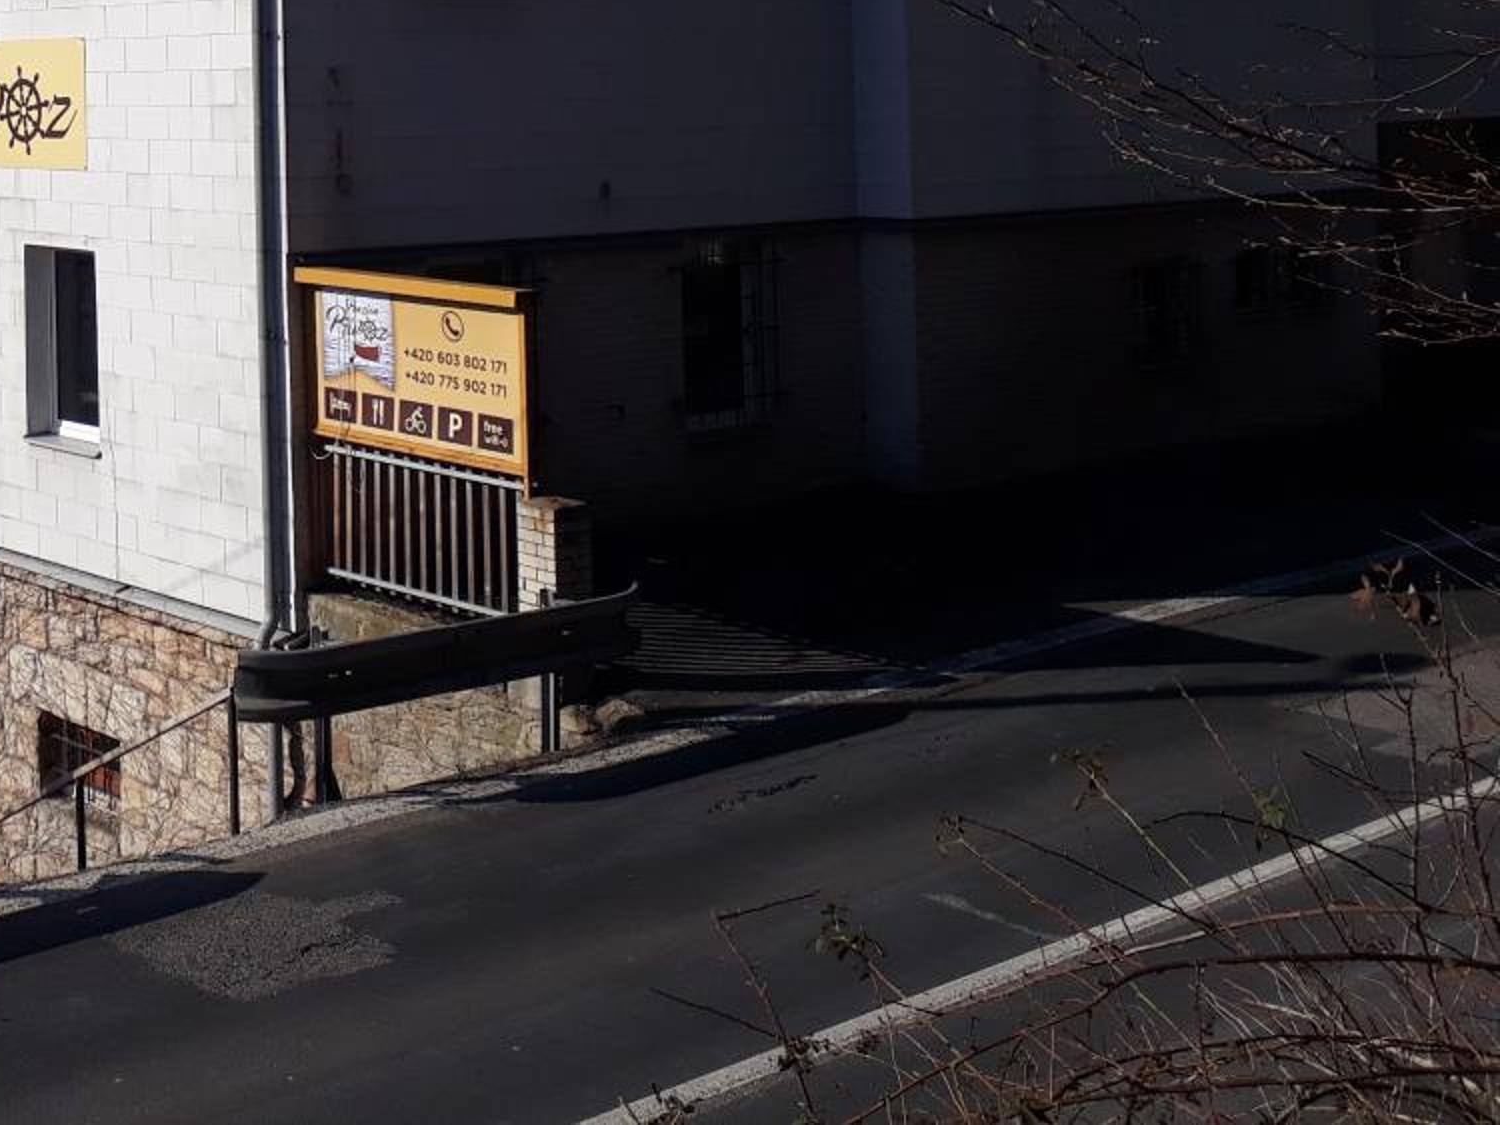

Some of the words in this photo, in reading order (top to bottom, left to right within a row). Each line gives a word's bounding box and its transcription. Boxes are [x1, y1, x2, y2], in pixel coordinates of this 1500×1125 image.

[404, 347, 434, 362] +420
[437, 350, 460, 366] 603
[464, 355, 487, 371] 802
[491, 359, 507, 374] 171
[405, 370, 435, 386] +420
[438, 374, 460, 390] 775
[463, 378, 487, 395] 902
[491, 382, 507, 399] 171
[448, 412, 463, 439] P
